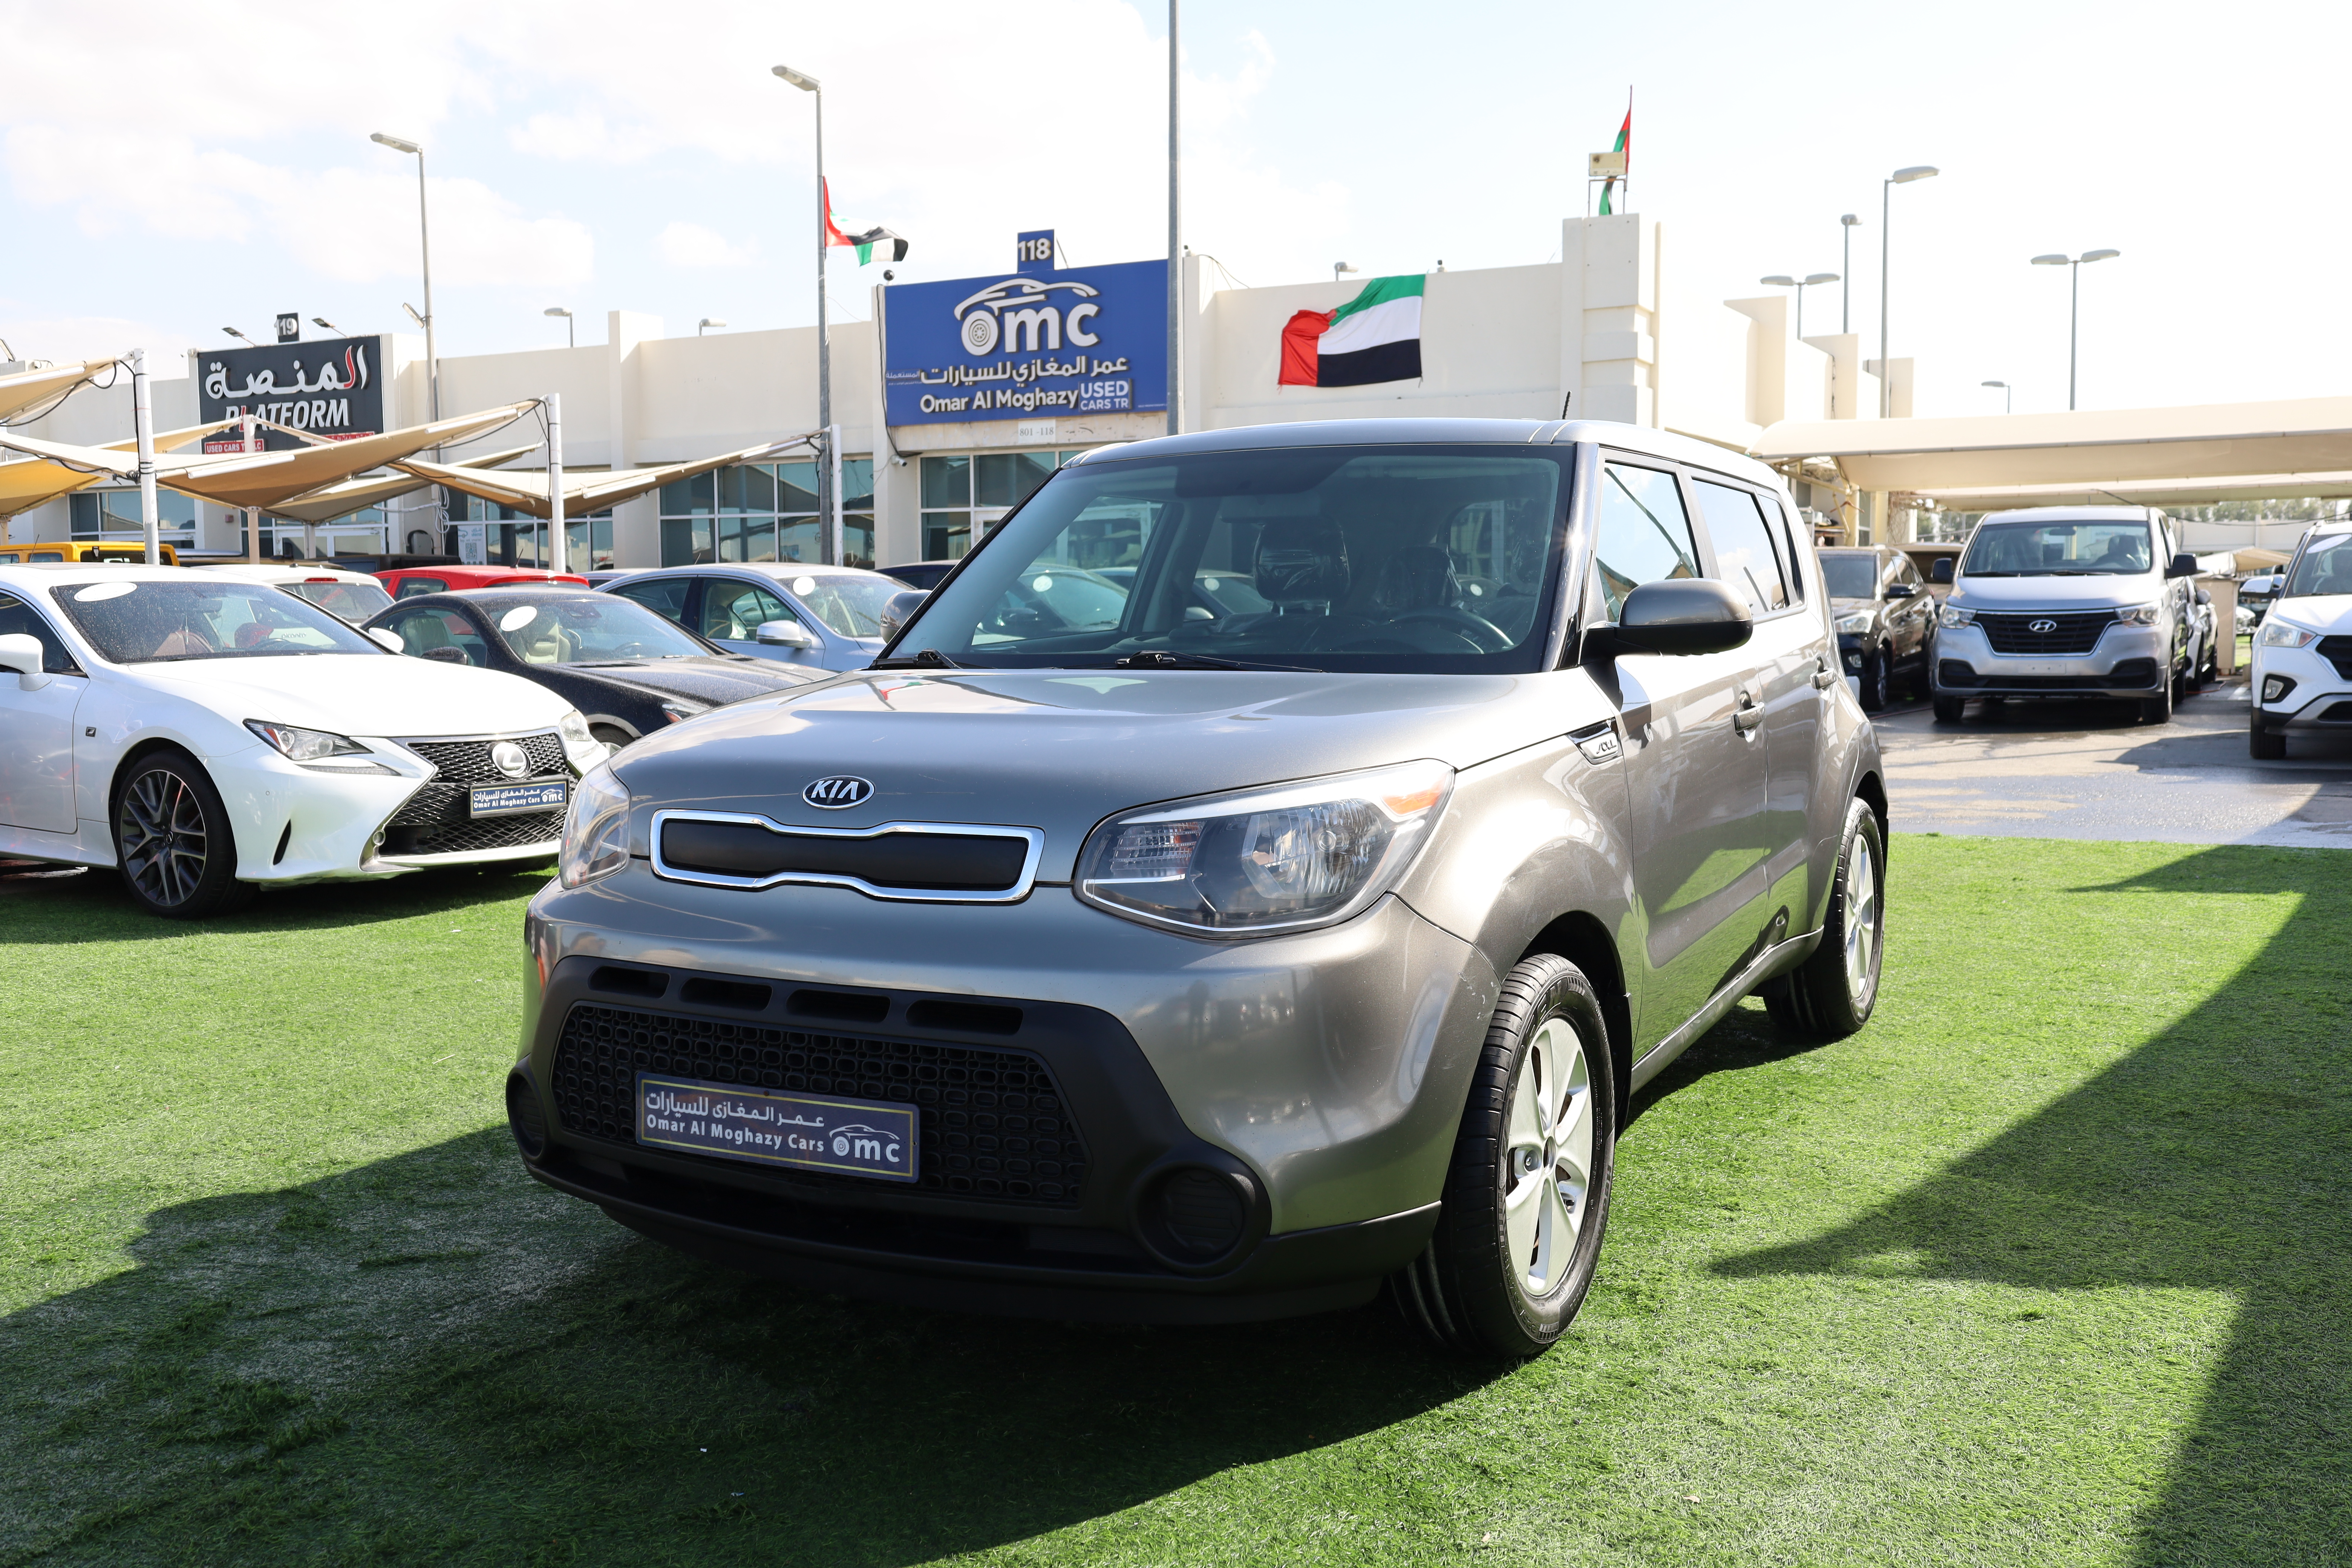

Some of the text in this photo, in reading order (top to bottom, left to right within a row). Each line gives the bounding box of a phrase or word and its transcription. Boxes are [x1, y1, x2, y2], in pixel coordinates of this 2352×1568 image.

[1018, 237, 1051, 261] 118
[274, 318, 297, 336] 119
[205, 345, 370, 399] المنصة
[921, 361, 1011, 387] للسيارات
[1012, 355, 1087, 387] المغازي
[1091, 357, 1129, 377] عمر
[1080, 380, 1129, 398] USED
[920, 387, 1079, 413] Omar Al Moghazy
[1080, 398, 1128, 410] CARS TR
[224, 398, 349, 433] PLATFORM
[1020, 428, 1033, 436] 801
[224, 443, 239, 452] CARS
[473, 790, 499, 802] للسيارات
[811, 780, 859, 800] KIA
[646, 1091, 709, 1118] للسيارات
[777, 1112, 825, 1127] عمر
[647, 1114, 824, 1152] Omar Al Moghazy Cars
